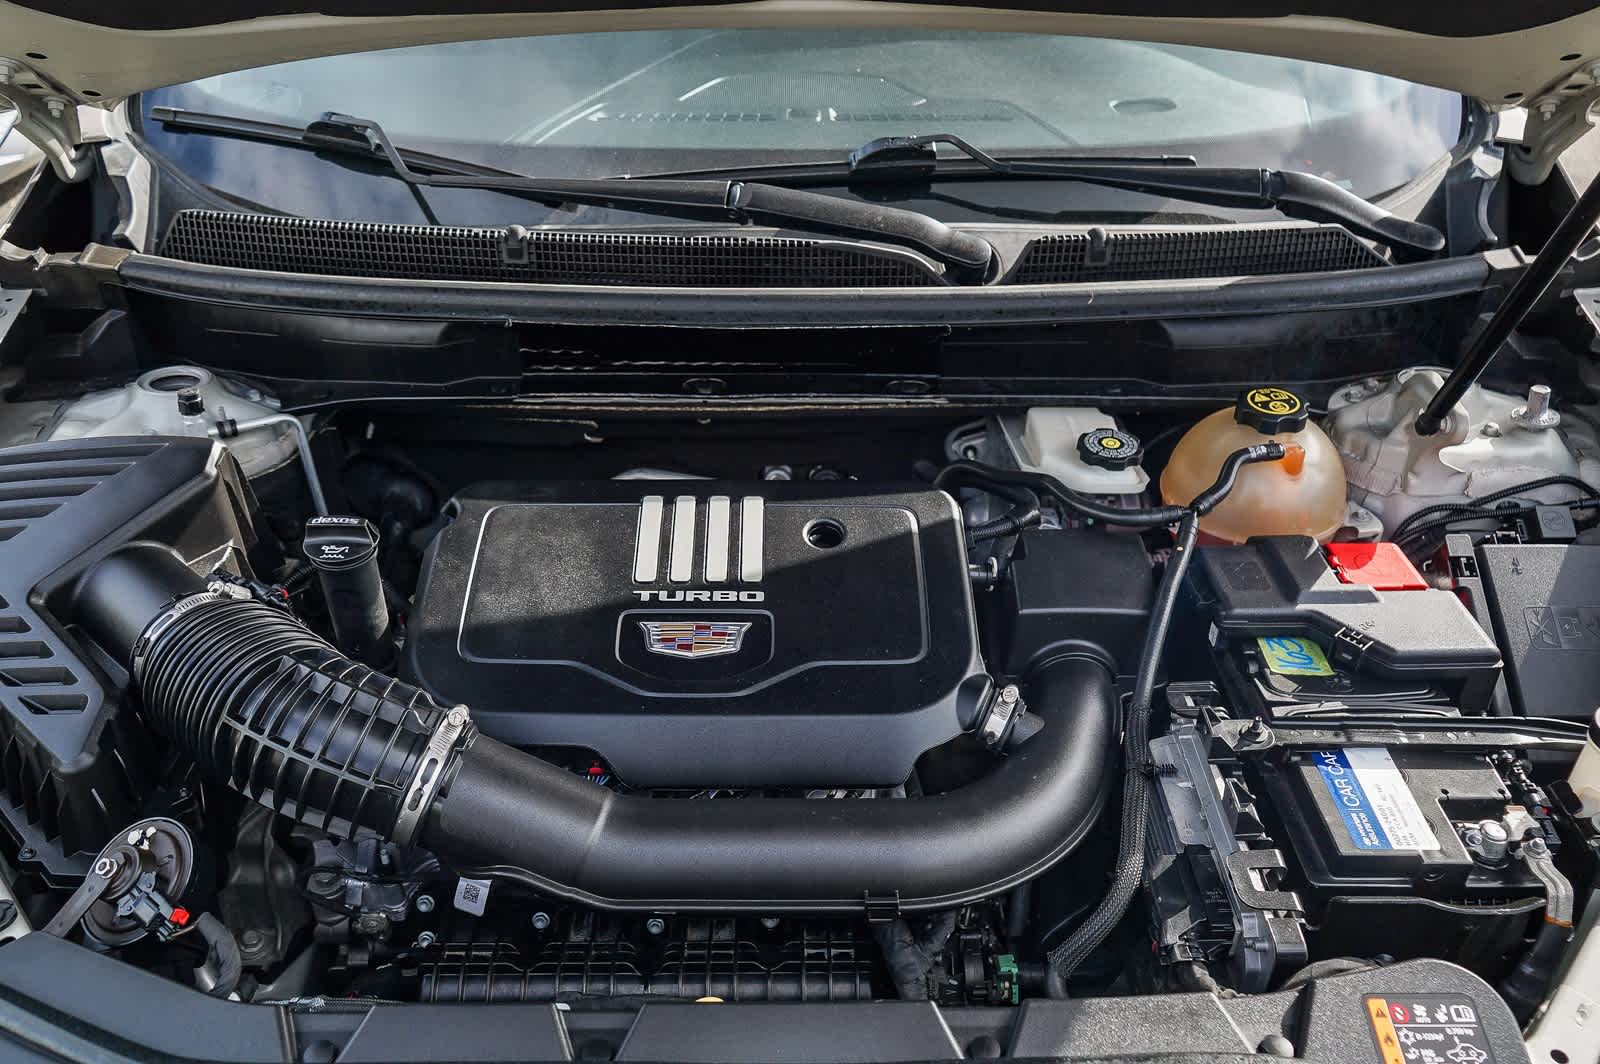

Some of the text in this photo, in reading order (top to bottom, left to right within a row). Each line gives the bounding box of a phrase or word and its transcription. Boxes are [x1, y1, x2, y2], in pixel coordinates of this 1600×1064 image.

[311, 516, 361, 525] dexos
[632, 590, 766, 602] TURBO
[1334, 778, 1360, 807] CAR
